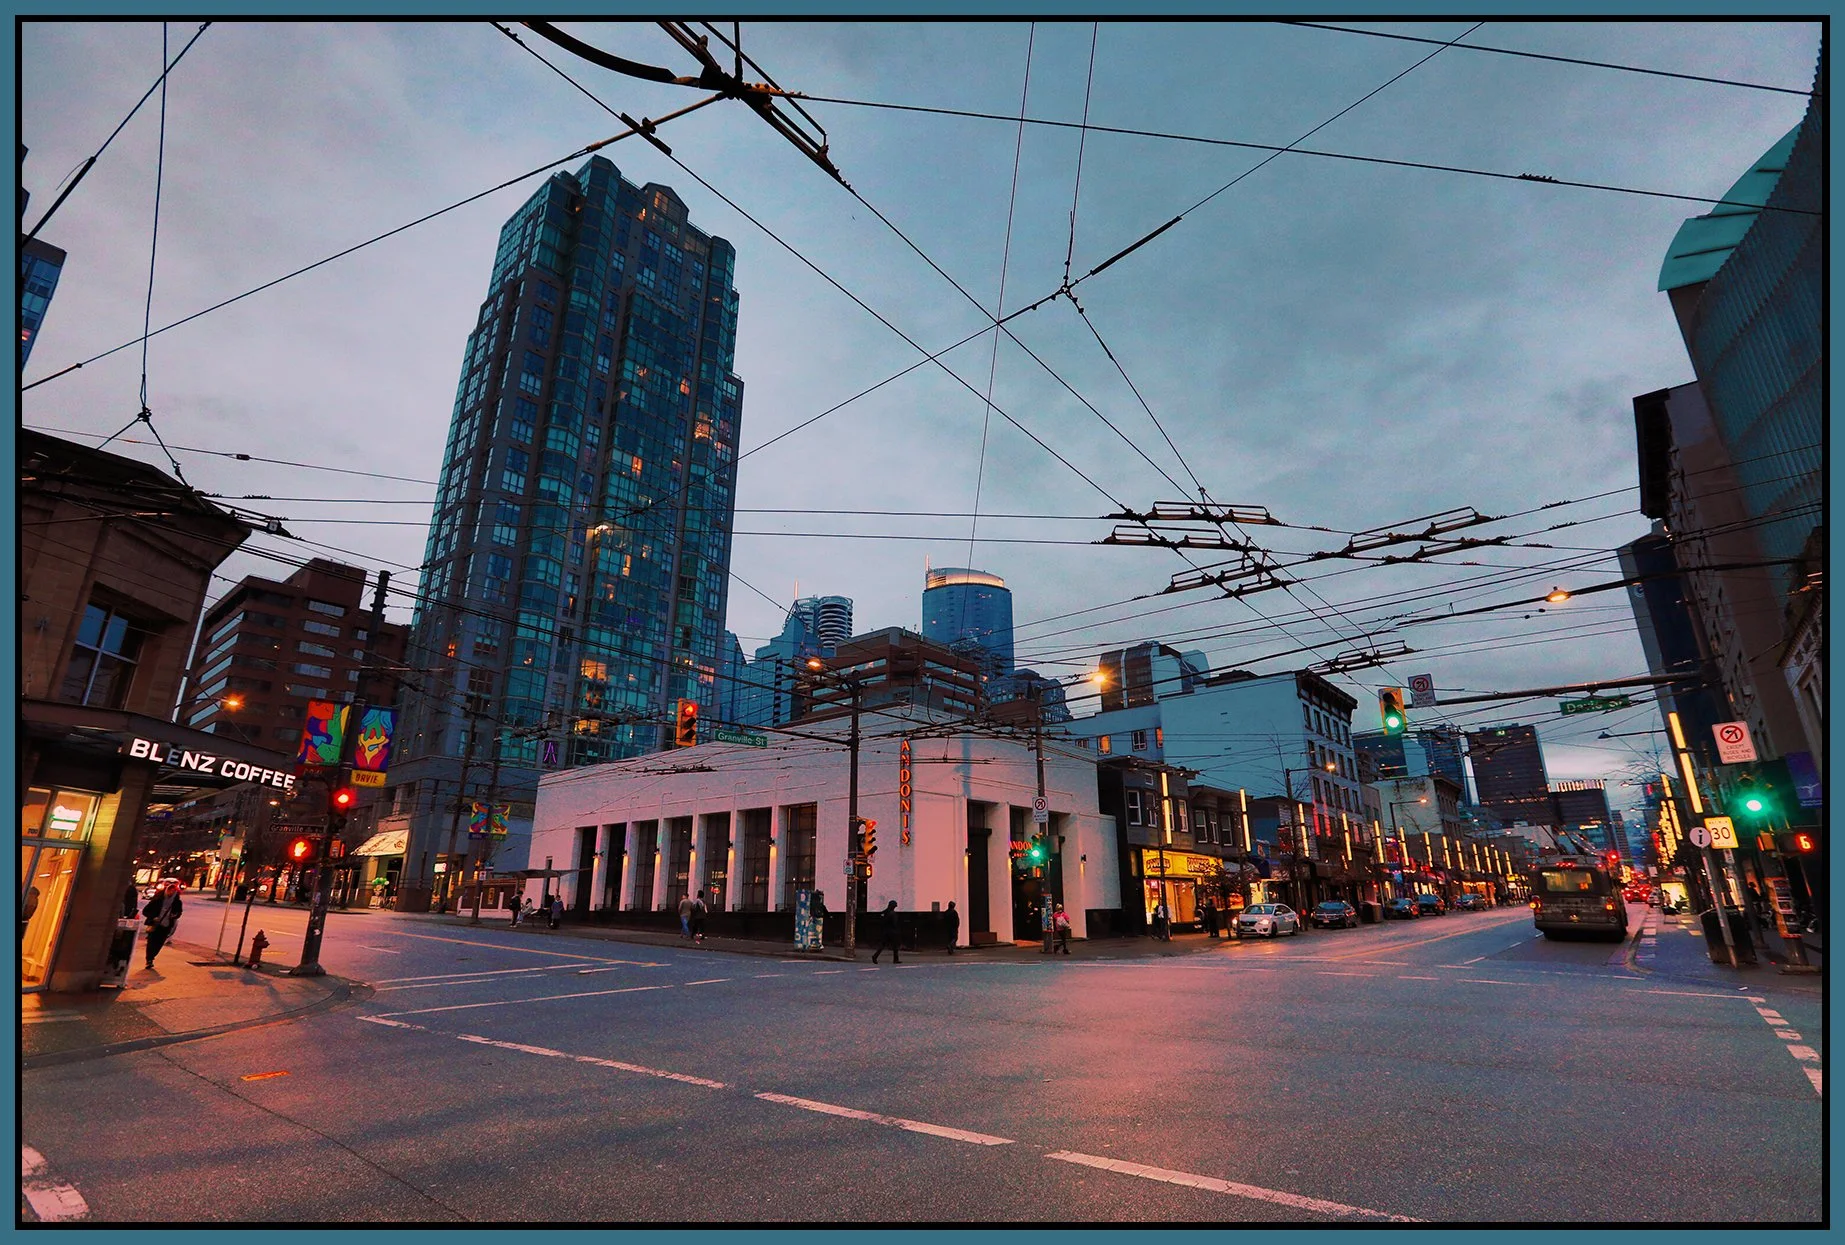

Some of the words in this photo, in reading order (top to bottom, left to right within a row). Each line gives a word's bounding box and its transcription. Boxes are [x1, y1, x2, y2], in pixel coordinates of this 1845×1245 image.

[717, 732, 752, 744] Granville
[755, 737, 764, 746] St
[129, 738, 216, 773] BLENZ
[220, 760, 296, 789] COFFEE
[900, 739, 911, 846] ANDONIS
[1711, 827, 1731, 840] 30
[1800, 835, 1811, 849] 6
[866, 866, 871, 876] 6
